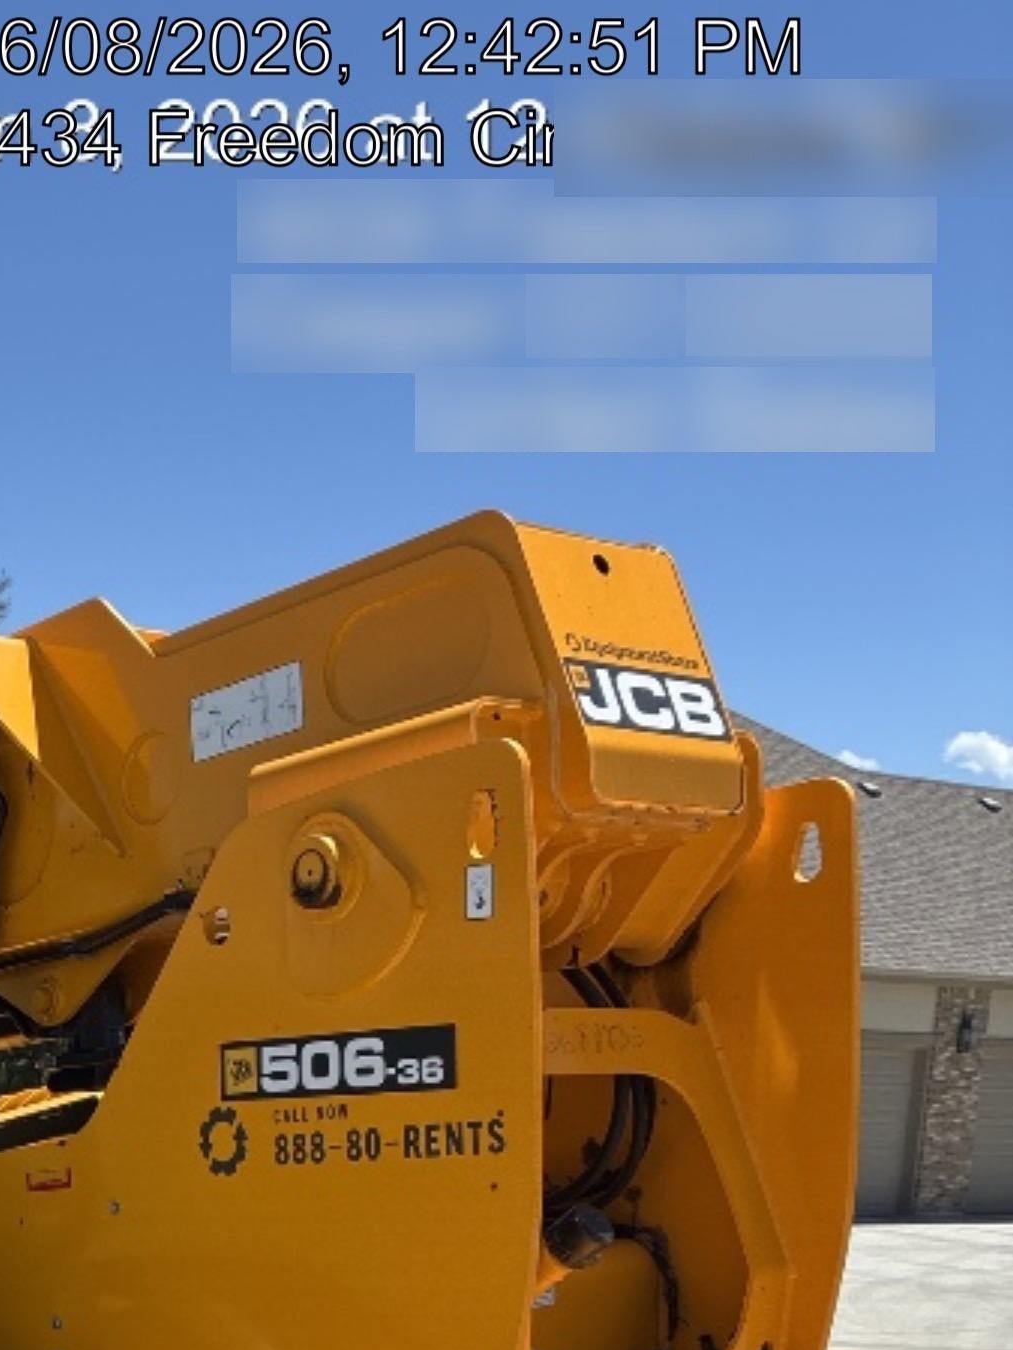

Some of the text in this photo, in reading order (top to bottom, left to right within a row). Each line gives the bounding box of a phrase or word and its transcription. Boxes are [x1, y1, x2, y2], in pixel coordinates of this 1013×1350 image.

[578, 668, 726, 736] JCB
[259, 1036, 445, 1093] 506-36
[273, 1119, 506, 1165] 888-80-RENTS
